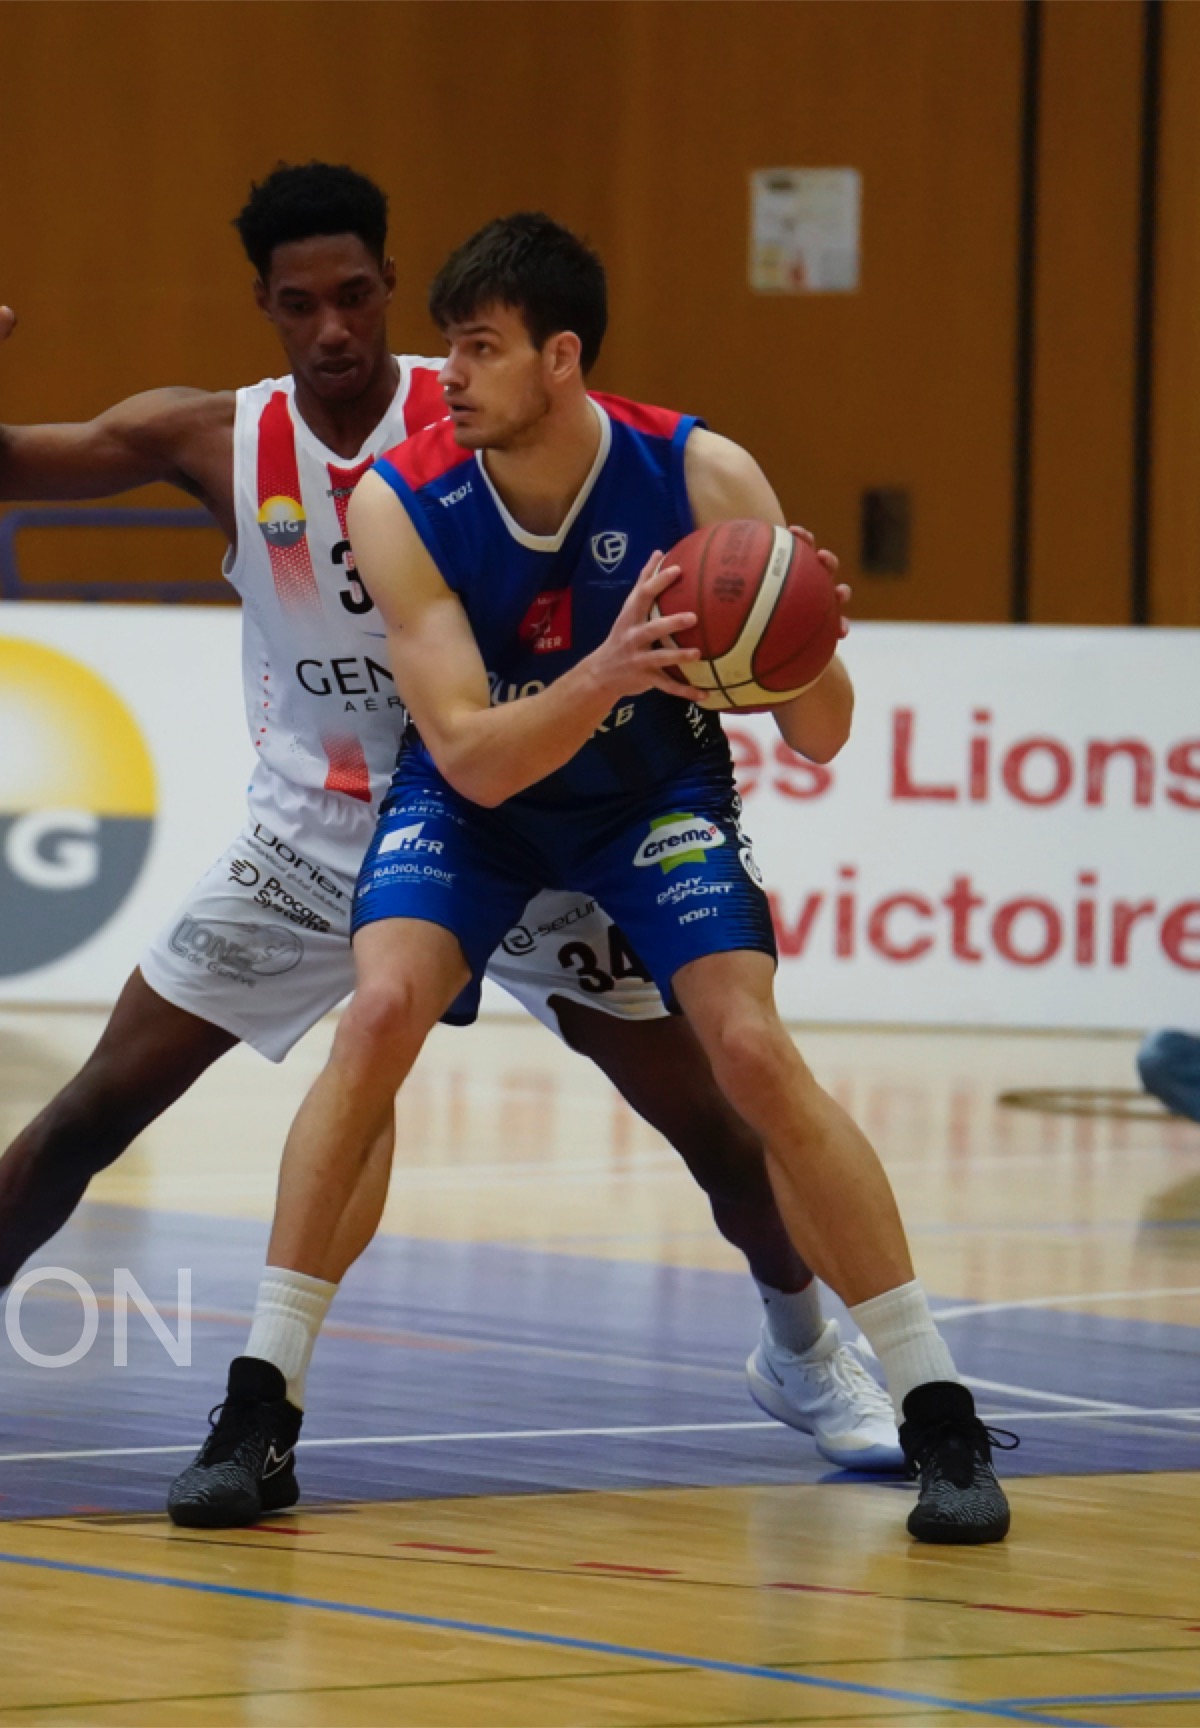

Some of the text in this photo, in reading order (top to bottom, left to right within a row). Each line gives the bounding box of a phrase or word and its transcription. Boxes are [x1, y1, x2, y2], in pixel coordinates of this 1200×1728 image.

[266, 519, 299, 534] SIG
[671, 881, 734, 905] SPORT
[766, 864, 1200, 973] victoire
[557, 923, 655, 993] 34
